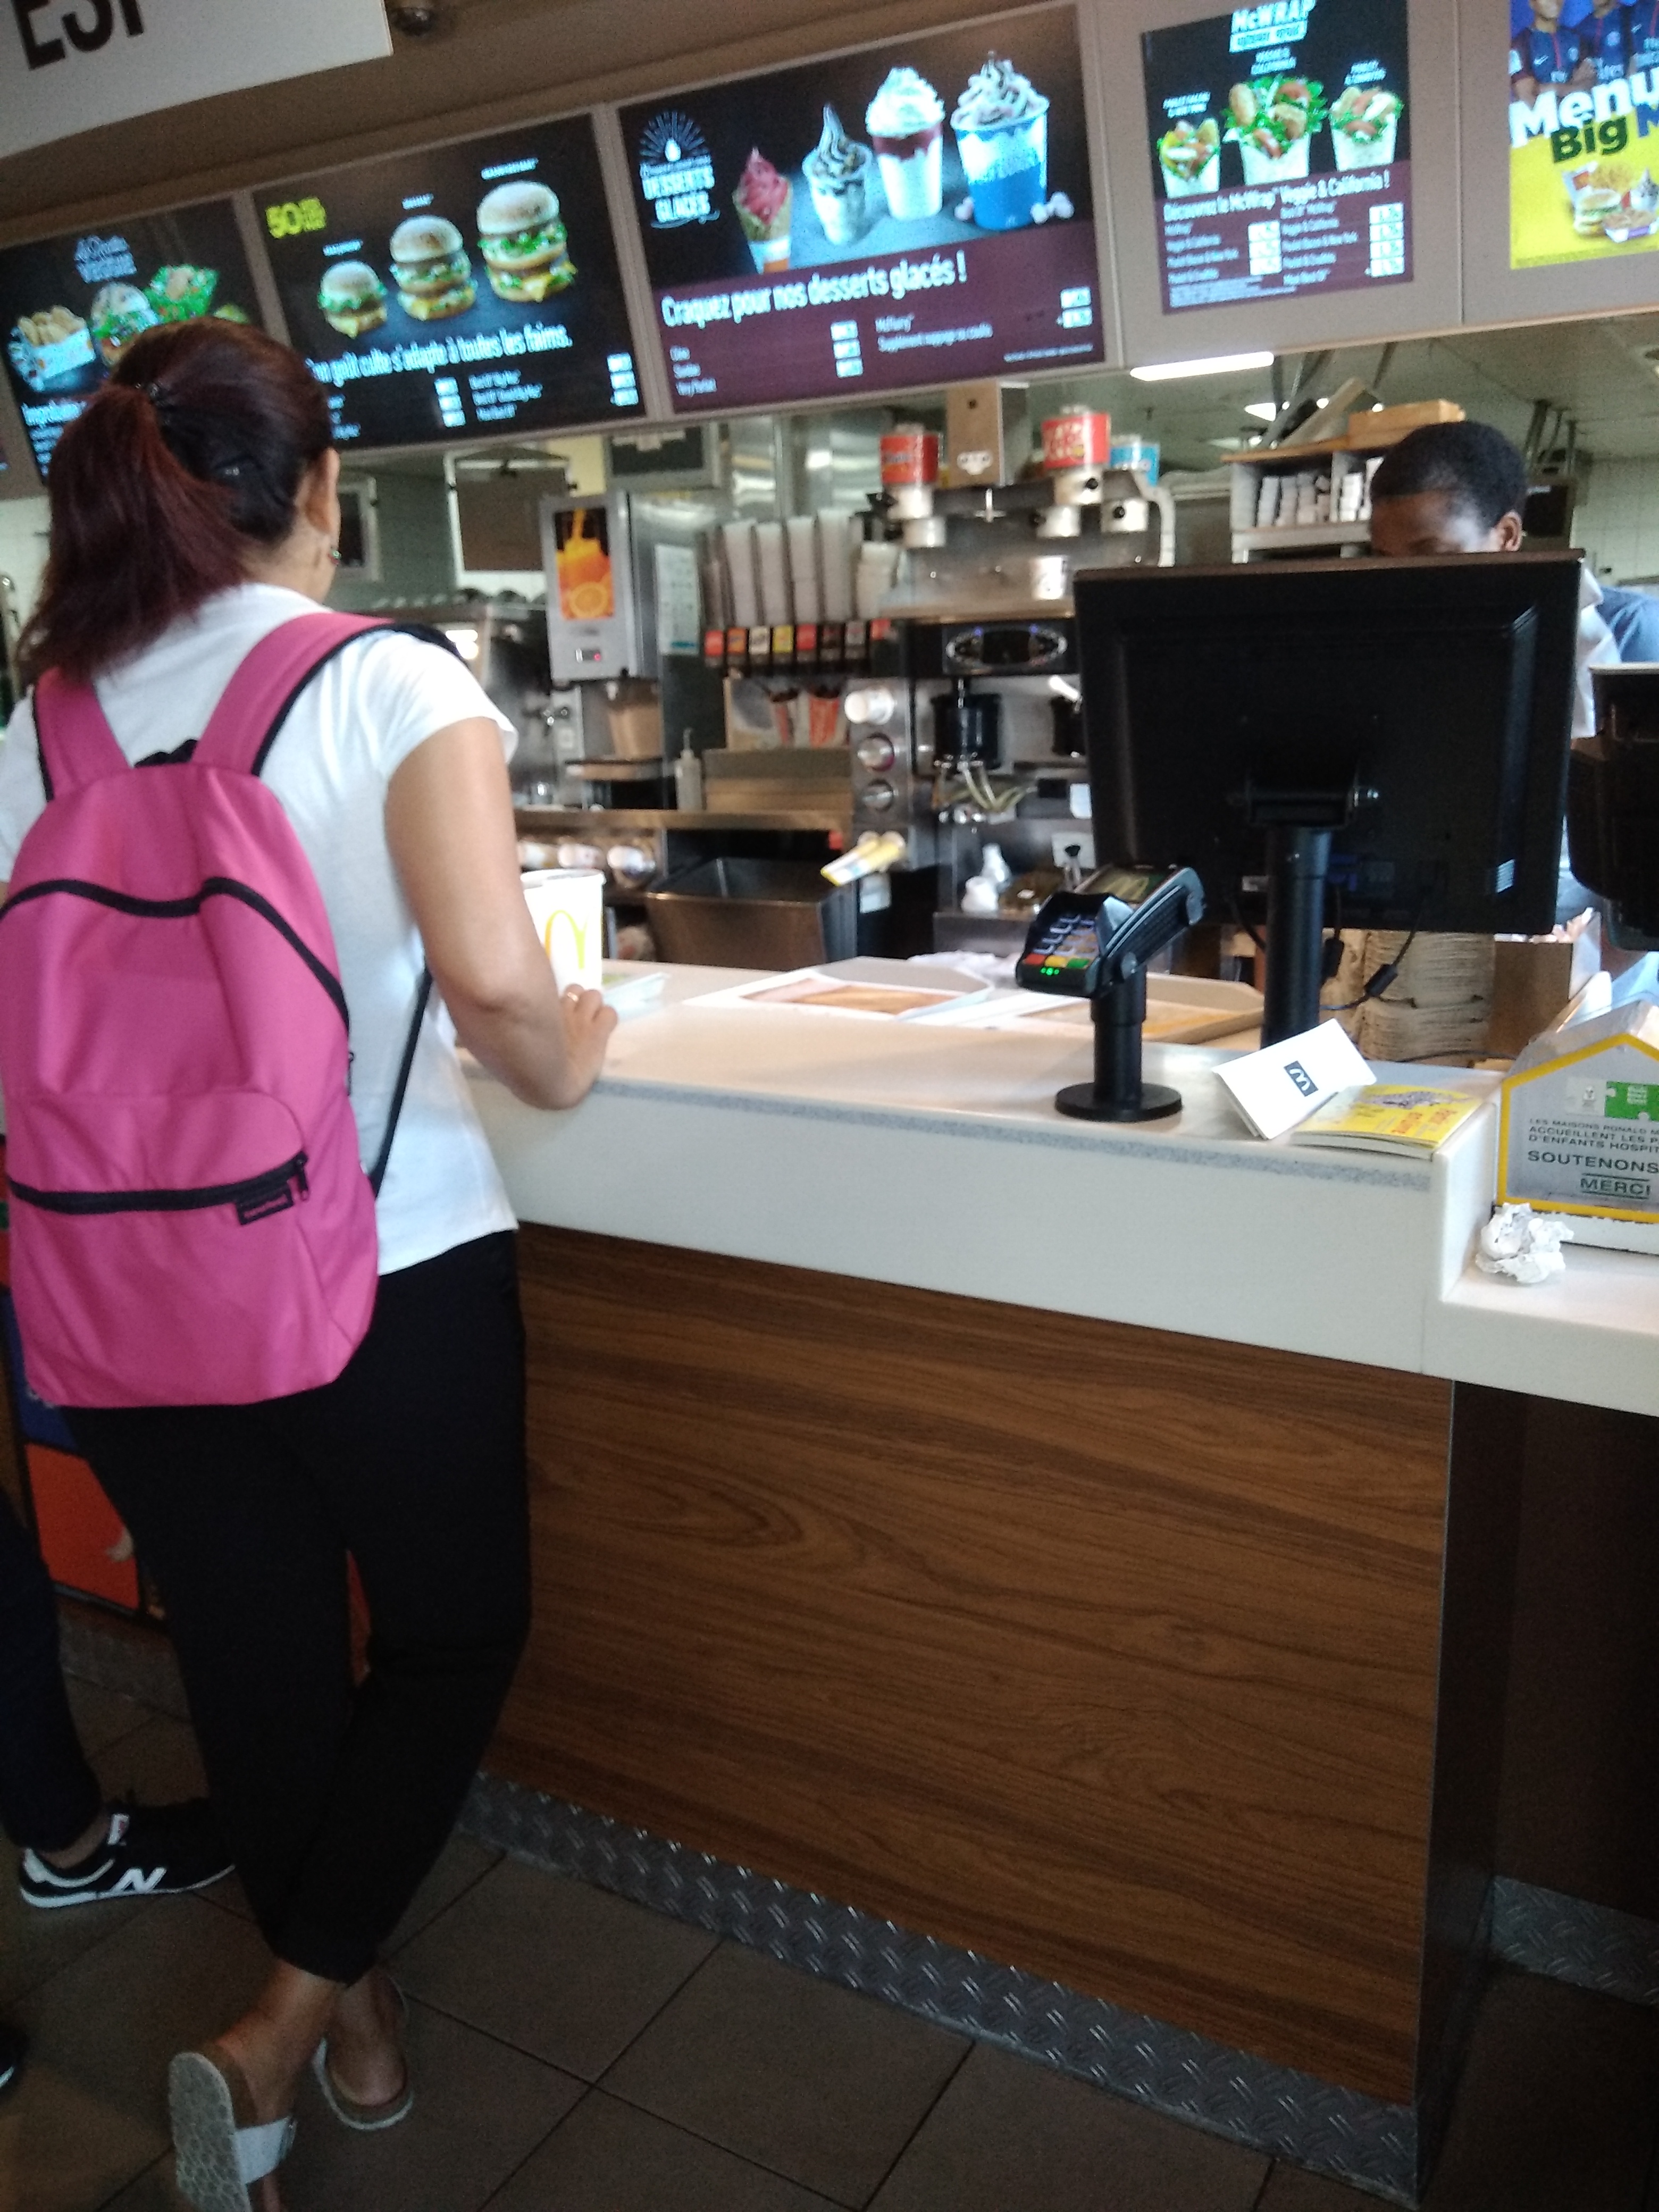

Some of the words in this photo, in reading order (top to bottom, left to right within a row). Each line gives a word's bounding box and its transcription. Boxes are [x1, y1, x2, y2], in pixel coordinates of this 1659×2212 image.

[1509, 67, 1659, 148] Menu
[1551, 115, 1628, 163] Big
[661, 294, 733, 329] Craquez
[731, 288, 772, 323] pour
[773, 281, 808, 311] nos
[808, 266, 890, 306] desserts
[890, 253, 956, 300] glacés
[1528, 1150, 1658, 1174] SOUTENONS
[1580, 1178, 1651, 1195] MERCI
